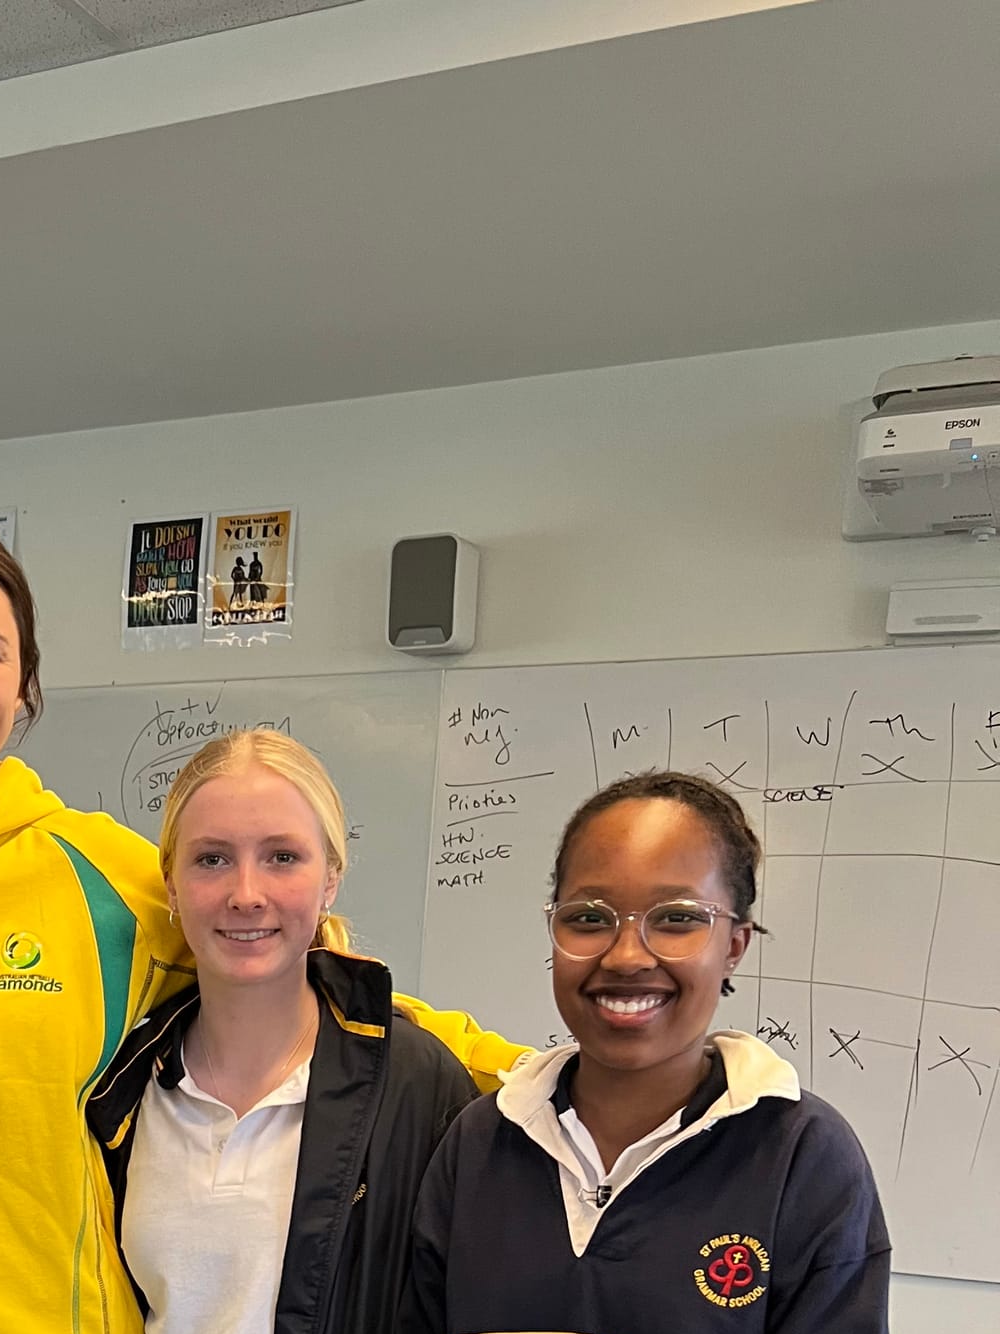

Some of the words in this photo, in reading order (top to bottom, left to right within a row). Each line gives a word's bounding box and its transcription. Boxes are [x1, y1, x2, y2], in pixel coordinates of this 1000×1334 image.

[945, 418, 981, 431] EPSON
[224, 525, 259, 541] YOU
[262, 522, 287, 538] DO
[168, 536, 197, 560] HOW
[136, 562, 159, 577] SLOW
[181, 558, 194, 574] GO
[167, 596, 193, 621] STOP
[703, 714, 742, 742] T
[796, 716, 832, 747] W
[869, 713, 936, 742] Th
[435, 844, 513, 866] SCIENCE
[699, 1244, 713, 1258] ST
[709, 1233, 741, 1249] PAUL'S
[741, 1235, 771, 1272] ANGLICAN
[693, 1268, 728, 1308] GRAMMAR
[728, 1285, 767, 1308] SCHOOL
